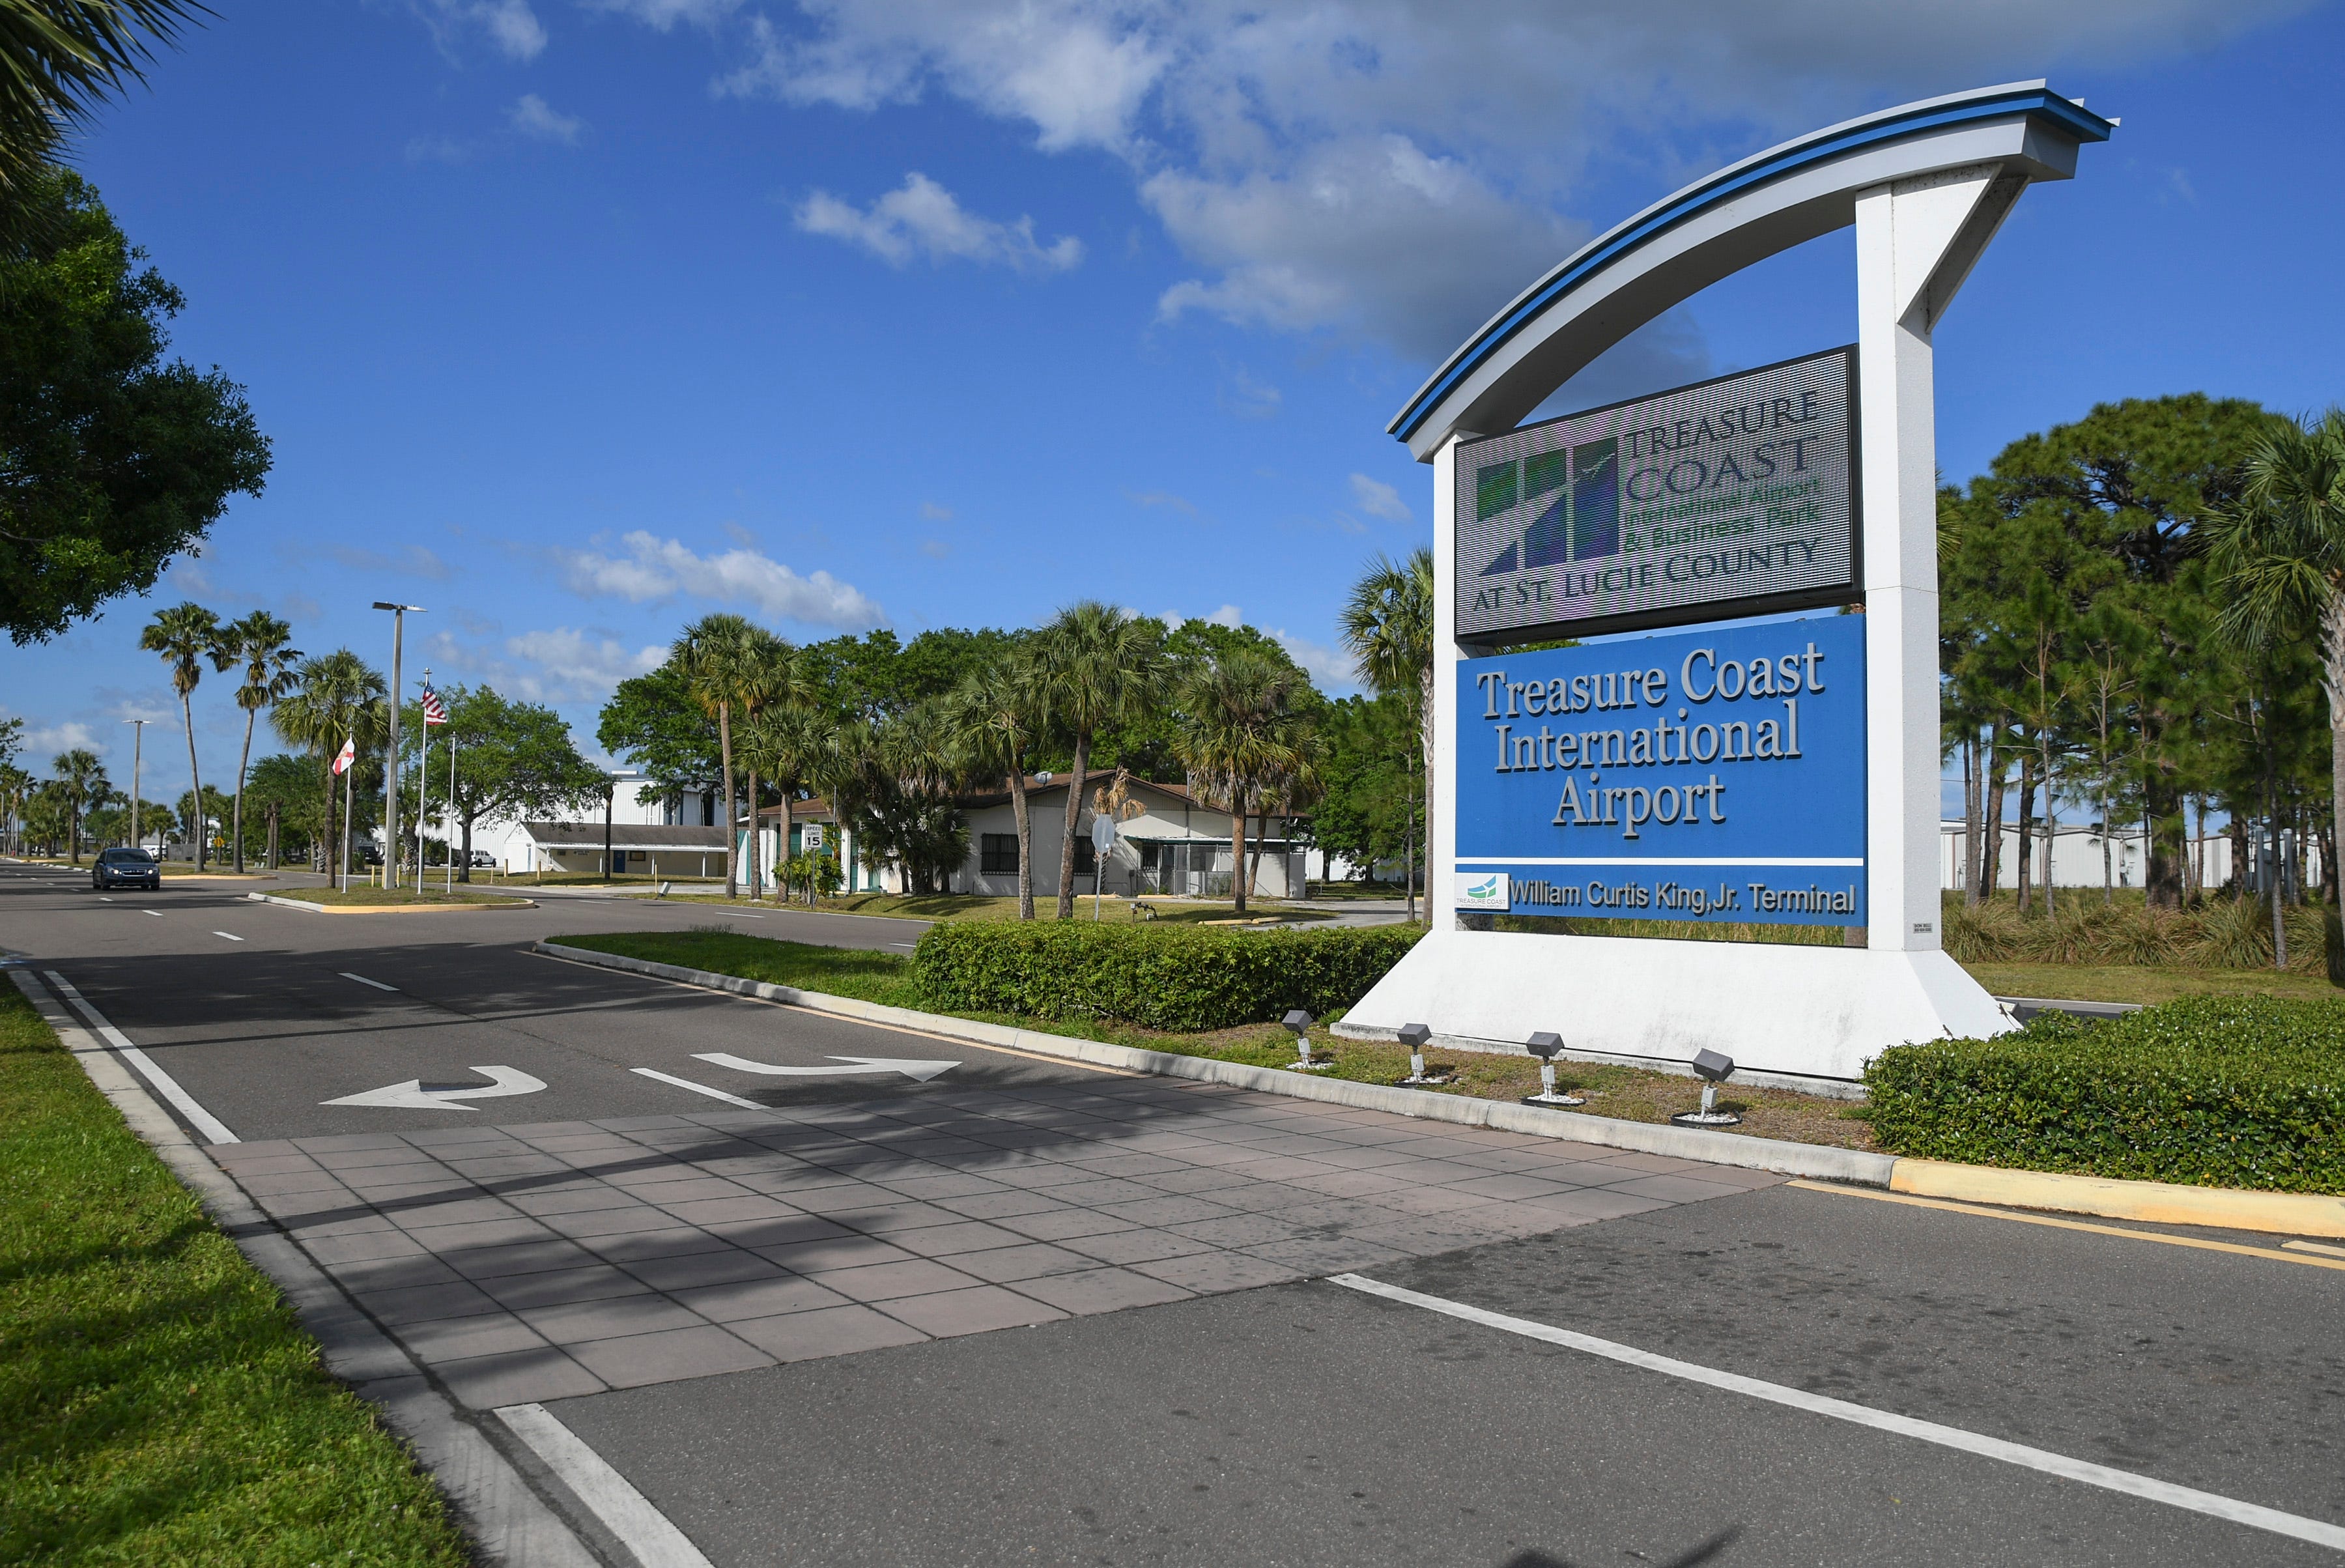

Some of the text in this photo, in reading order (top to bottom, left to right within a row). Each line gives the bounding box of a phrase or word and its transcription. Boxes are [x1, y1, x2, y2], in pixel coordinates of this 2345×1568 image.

[1625, 391, 1818, 459] TREASURE
[1626, 435, 1819, 502] COAST
[1625, 479, 1821, 527] International Airport
[1625, 500, 1822, 552] & Business Park
[1473, 586, 1506, 611] AT
[1565, 563, 1653, 598] LUCIE
[1666, 537, 1821, 582] COUNTY
[1477, 642, 1825, 719] Treasure Coast
[1494, 698, 1802, 773] International
[1551, 772, 1726, 838] Airport
[807, 836, 820, 846] 15
[1509, 879, 1582, 904] William
[1587, 880, 1649, 906] Curtis
[1747, 883, 1856, 912] Terminal
